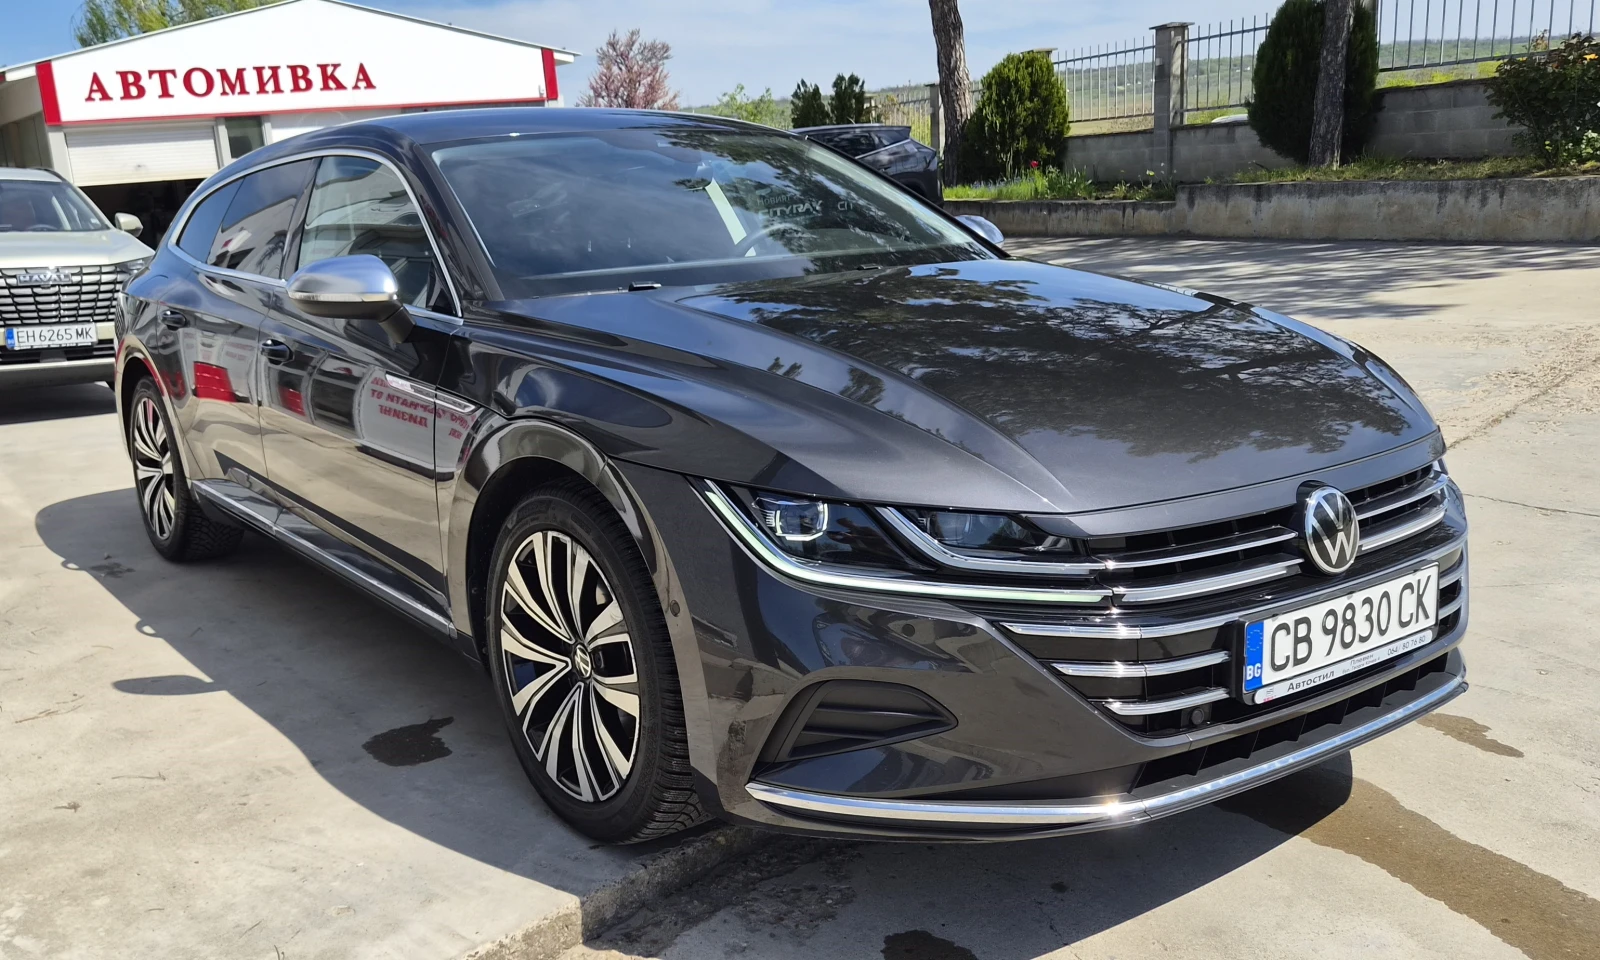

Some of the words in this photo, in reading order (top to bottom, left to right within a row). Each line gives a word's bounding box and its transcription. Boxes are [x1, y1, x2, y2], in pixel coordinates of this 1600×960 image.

[84, 62, 376, 102] АВТОМИВКА
[19, 272, 69, 282] HAVAL
[17, 330, 36, 344] EH
[39, 328, 73, 342] 6265
[75, 327, 93, 340] MK
[1270, 616, 1313, 672] CB
[1321, 590, 1392, 657] 9830
[1398, 574, 1432, 629] CK
[1246, 664, 1262, 680] BG
[1287, 670, 1335, 692] Автостил
